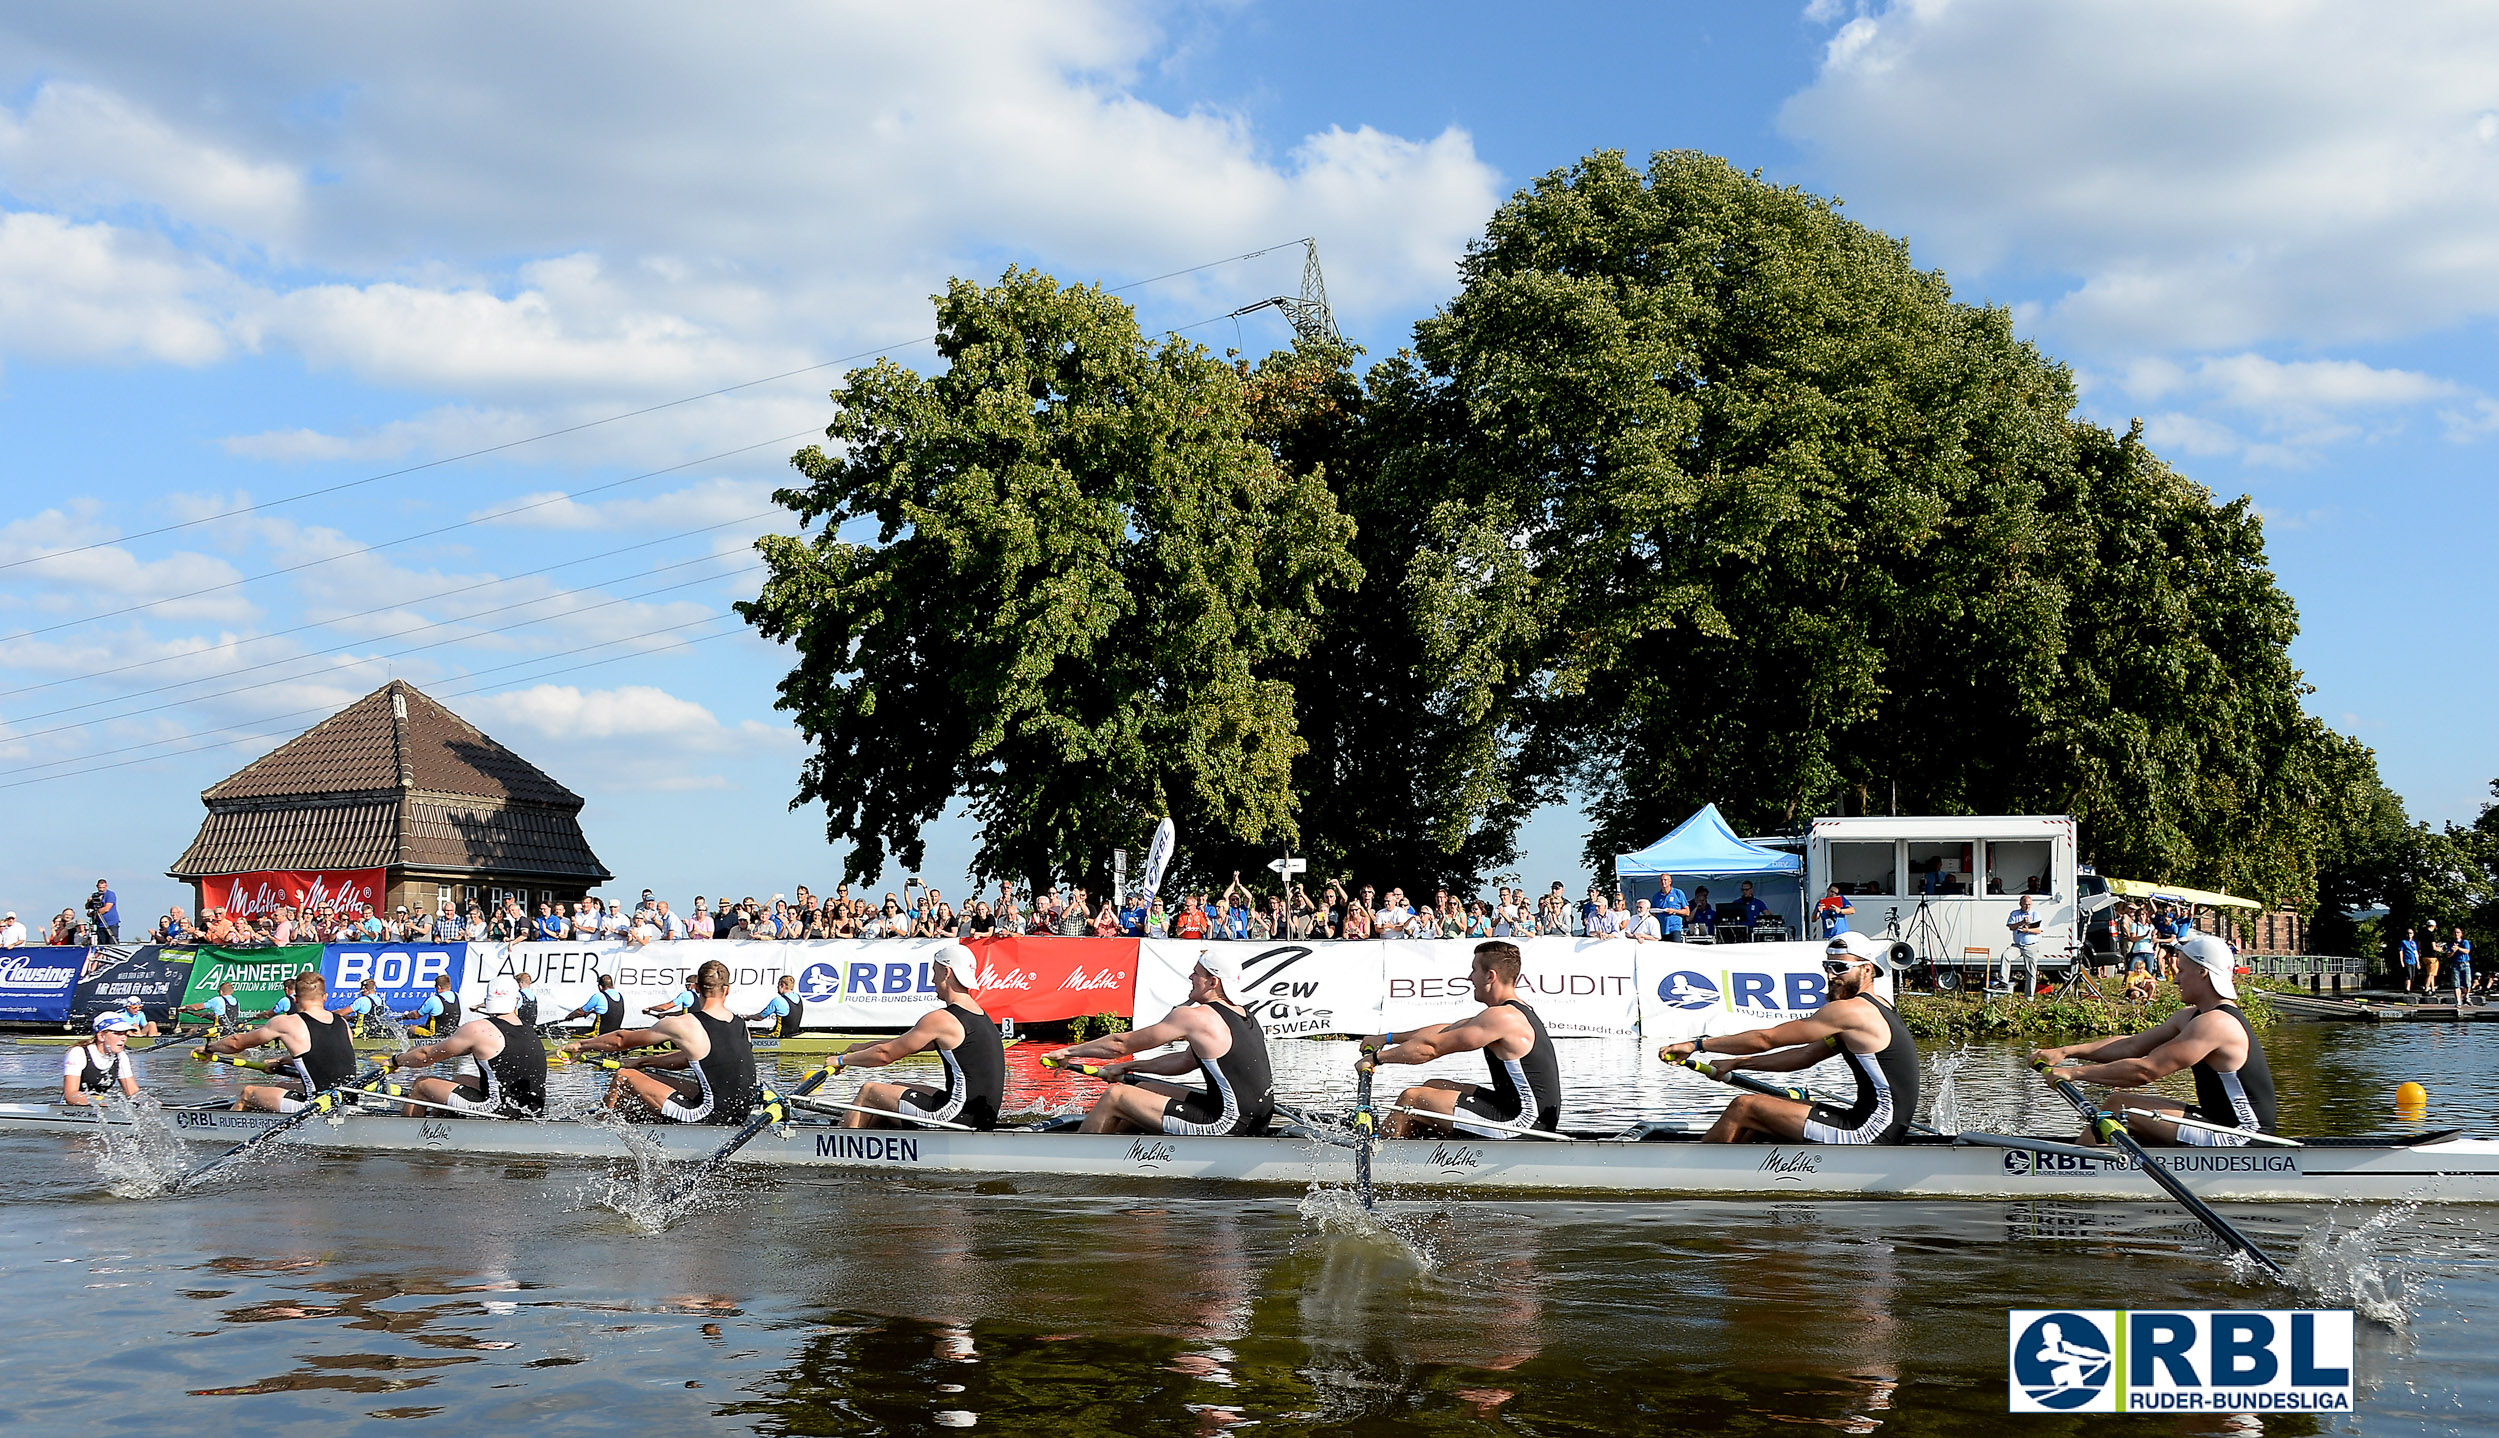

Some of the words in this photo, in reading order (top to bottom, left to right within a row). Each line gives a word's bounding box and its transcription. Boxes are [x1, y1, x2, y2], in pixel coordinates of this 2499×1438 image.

[225, 877, 281, 917] Melitta
[303, 874, 365, 913] Melitta
[334, 951, 451, 989] BOB
[619, 968, 691, 986] BEST
[728, 968, 783, 986] UDIT
[847, 962, 937, 994] RBL
[977, 963, 1032, 991] Melitta
[1057, 964, 1120, 991] Melitta
[393, 991, 437, 999] BESTAN
[1389, 976, 1473, 998] BES
[1514, 973, 1631, 996] AUDIT
[1732, 973, 1828, 1010] RB
[845, 994, 940, 1004] RUDER-BUNDESLIGA
[1004, 1018, 1011, 1032] 3
[1262, 1019, 1331, 1036] TSWEAR
[1543, 1020, 1633, 1036] .bestaudit.de
[190, 1112, 217, 1127] RBL
[416, 1119, 450, 1140] Melitta
[815, 1133, 919, 1162] MINDEN
[1123, 1137, 1172, 1162] Melitta
[1424, 1142, 1479, 1168] Melitta
[1757, 1146, 1818, 1174] Melitta
[2103, 1156, 2296, 1172] RDR-BUNDESLIGA
